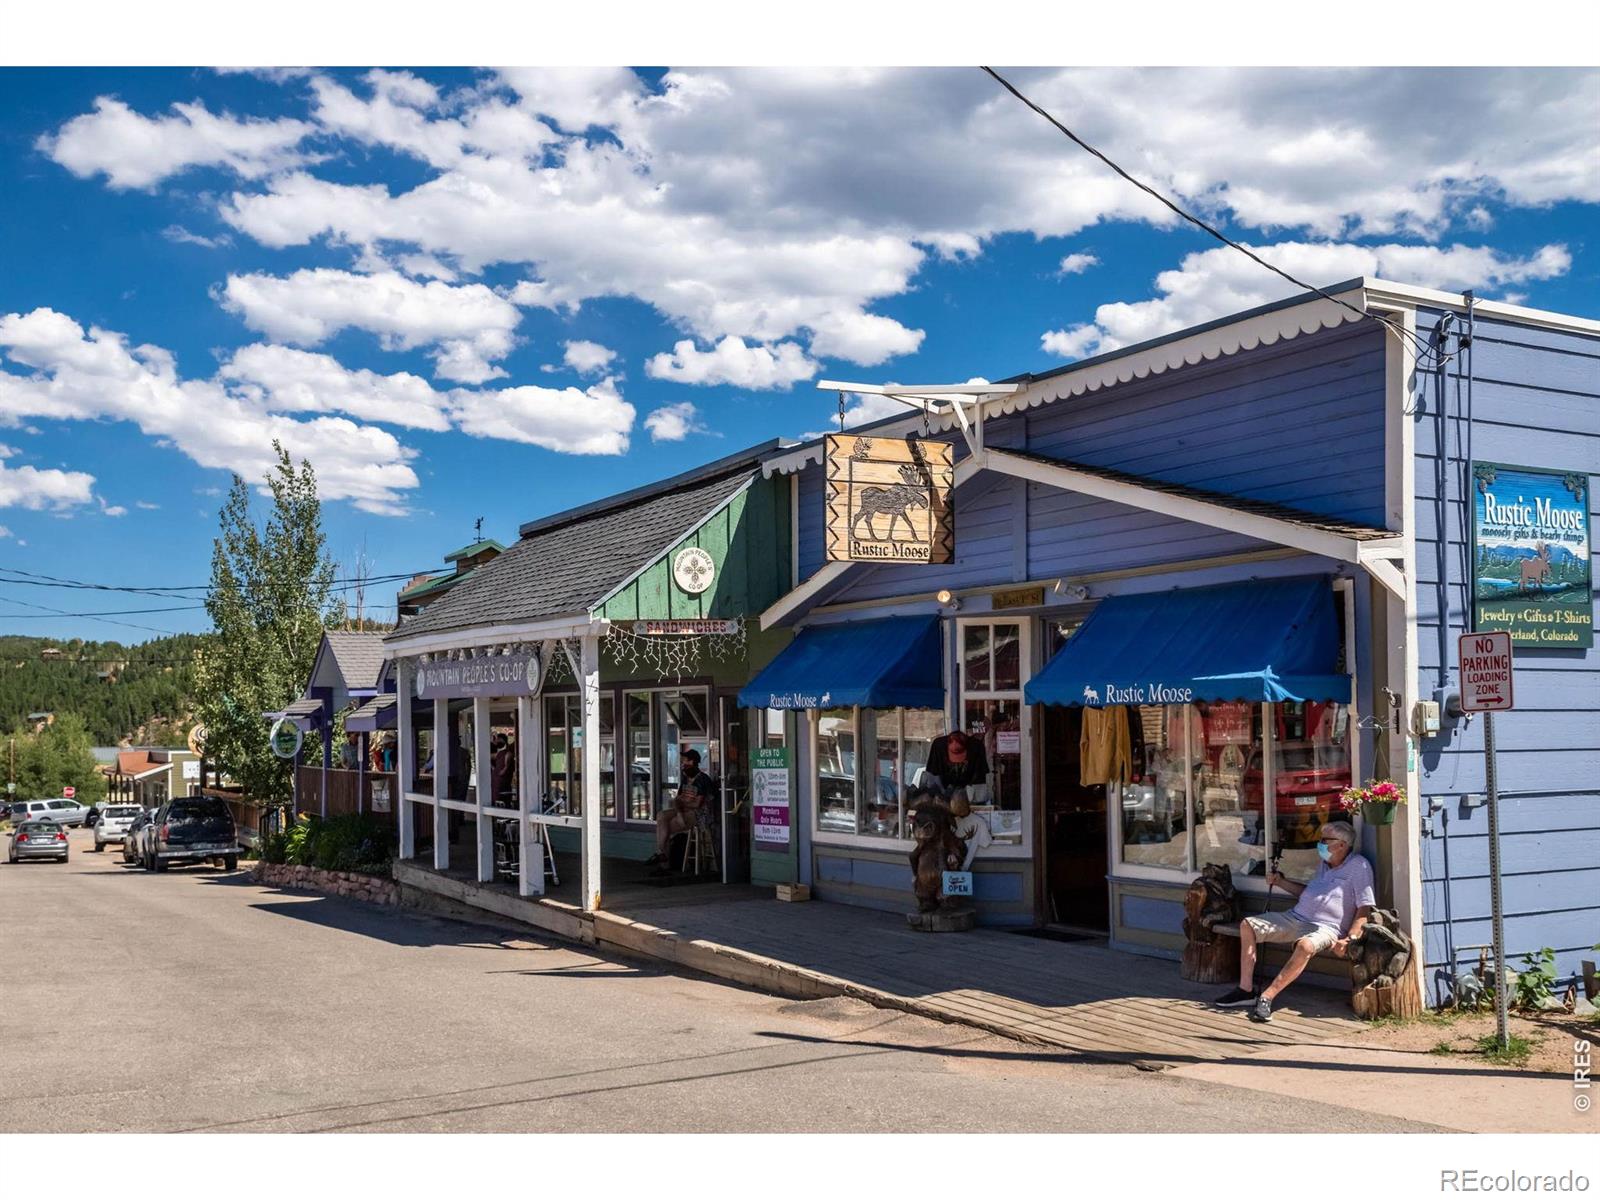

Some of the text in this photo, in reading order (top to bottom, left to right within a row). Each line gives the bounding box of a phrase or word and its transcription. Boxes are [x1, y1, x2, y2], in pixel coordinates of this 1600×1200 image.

[1483, 492, 1584, 530] Rustic Moose
[1481, 526, 1585, 545] moosely gifts & bearly things
[853, 541, 929, 558] Rustic Moose
[1480, 608, 1592, 625] Jewelry Gifts T-Shirts
[646, 621, 727, 633] SANDWICHES
[1541, 628, 1579, 641] Colorado
[1475, 639, 1494, 654] NO
[1463, 654, 1508, 672] PARKING
[426, 667, 460, 687] MOUNTAIN
[499, 662, 524, 682] CO-OP
[1468, 671, 1508, 684] LOADING
[1106, 683, 1192, 703] Rustic Moose
[1475, 684, 1500, 695] ZONE
[770, 692, 817, 708] Rustic Moose
[760, 748, 780, 757] OPEN TO
[757, 759, 784, 767] THE PUBLIC
[948, 884, 969, 893] OPEN
